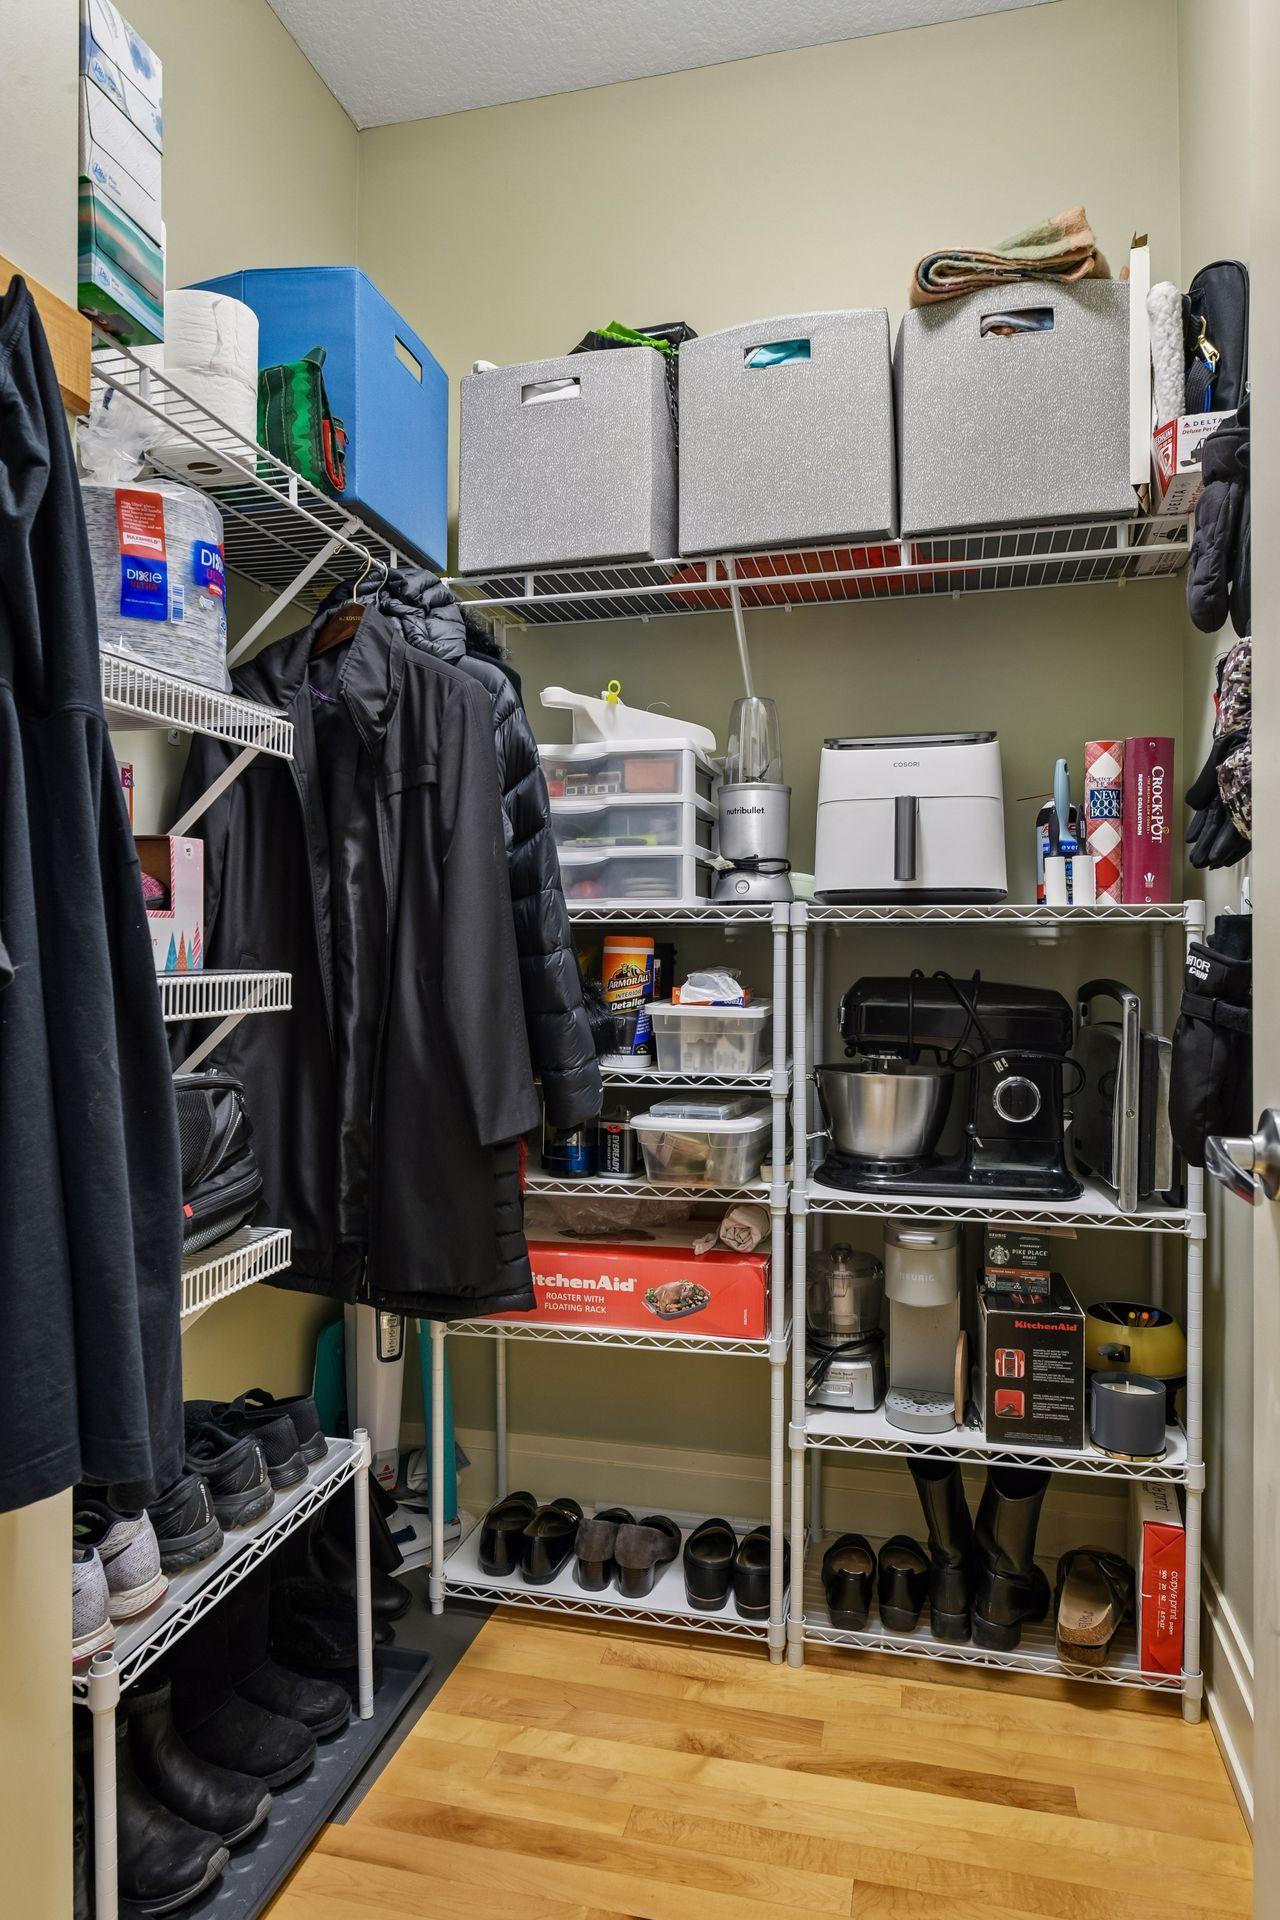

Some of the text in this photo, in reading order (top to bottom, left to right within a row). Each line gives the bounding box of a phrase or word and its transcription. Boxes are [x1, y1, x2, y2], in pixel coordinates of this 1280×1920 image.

[1167, 489, 1187, 512] DELTA
[124, 771, 131, 785] XS
[1094, 790, 1119, 800] NEW
[1090, 799, 1120, 808] COOK
[1090, 807, 1120, 817] BOOK
[611, 998, 645, 1012] Detailer
[612, 1134, 620, 1172] EVEREADY
[1027, 1249, 1048, 1257] PLACE
[532, 1272, 635, 1292] itchenAid
[546, 1292, 605, 1303] ROASTER WITH
[545, 1302, 607, 1314] FLOATING RACK
[1014, 1320, 1078, 1332] KitchenAid
[1169, 1571, 1178, 1594] copy
[1168, 1599, 1178, 1620] print
